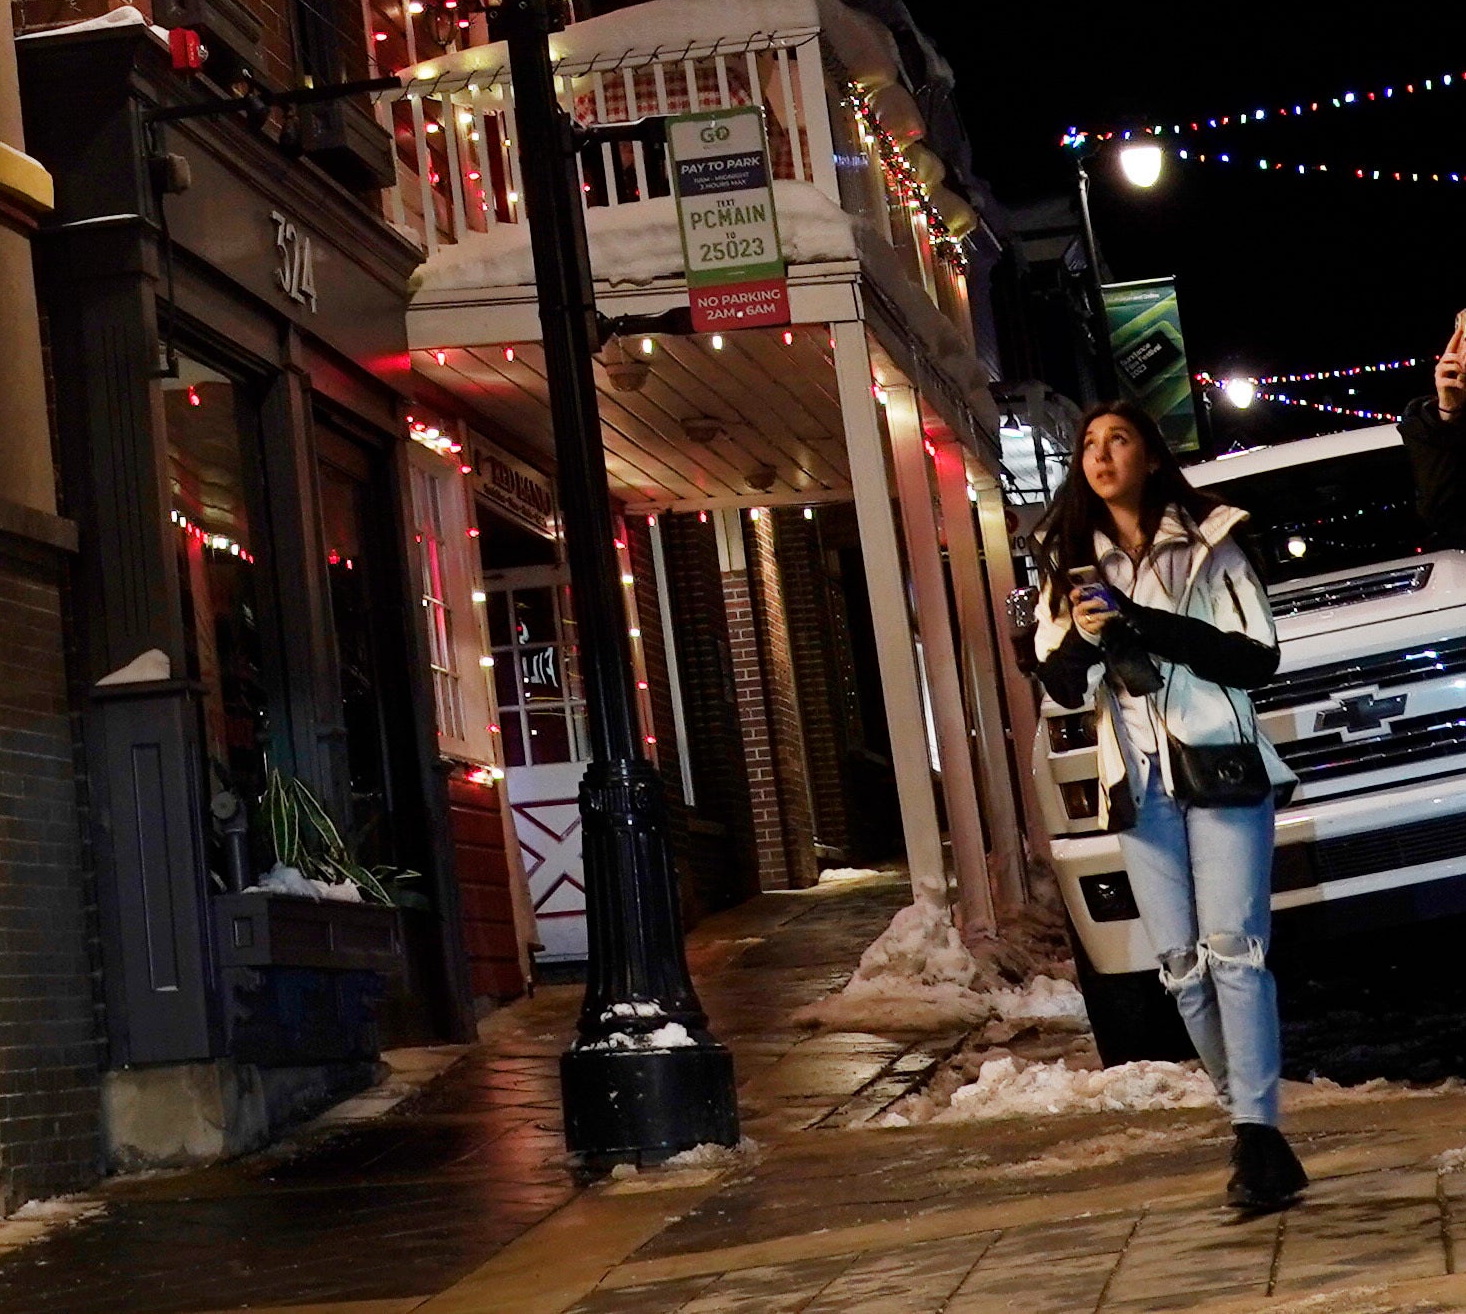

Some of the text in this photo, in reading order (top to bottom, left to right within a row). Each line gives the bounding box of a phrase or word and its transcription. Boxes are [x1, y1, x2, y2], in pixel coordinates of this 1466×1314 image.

[681, 156, 761, 174] PAY TO PARK
[690, 203, 767, 230] PCMAIN
[700, 238, 764, 262] 25023
[697, 289, 781, 308] NO PARKING
[706, 303, 776, 321] 2AM 6AM
